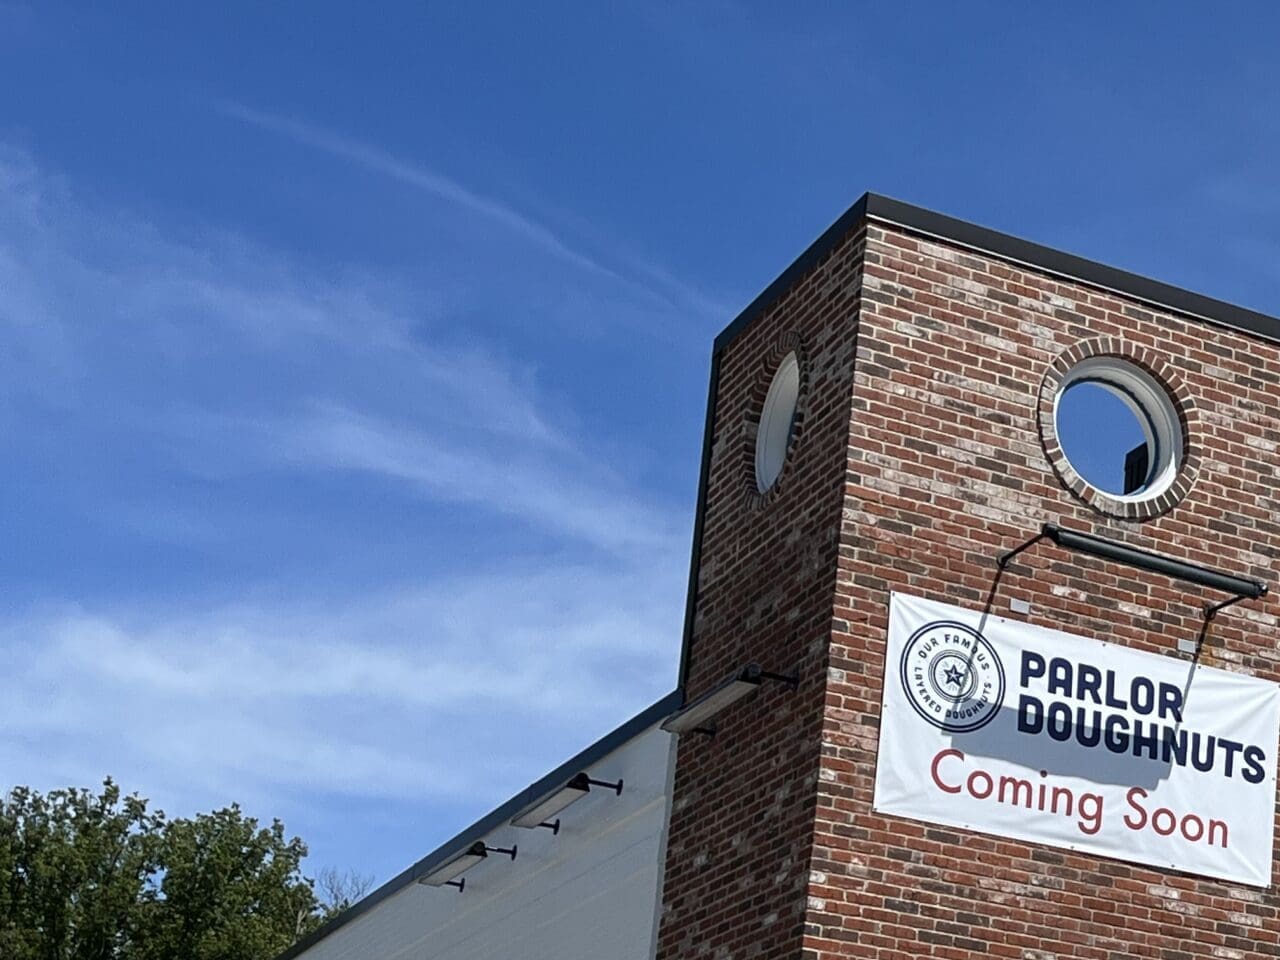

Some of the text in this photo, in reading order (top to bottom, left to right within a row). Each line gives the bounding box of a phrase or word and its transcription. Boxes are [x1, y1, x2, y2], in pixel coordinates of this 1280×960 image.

[918, 634, 990, 671] OUR FAMOUS
[1020, 650, 1183, 722] PARLOR
[914, 667, 992, 719] LAYERED DOUGHNUTS
[1017, 694, 1266, 784] DOUGHNUTS
[931, 749, 1229, 848] Coming Soon
